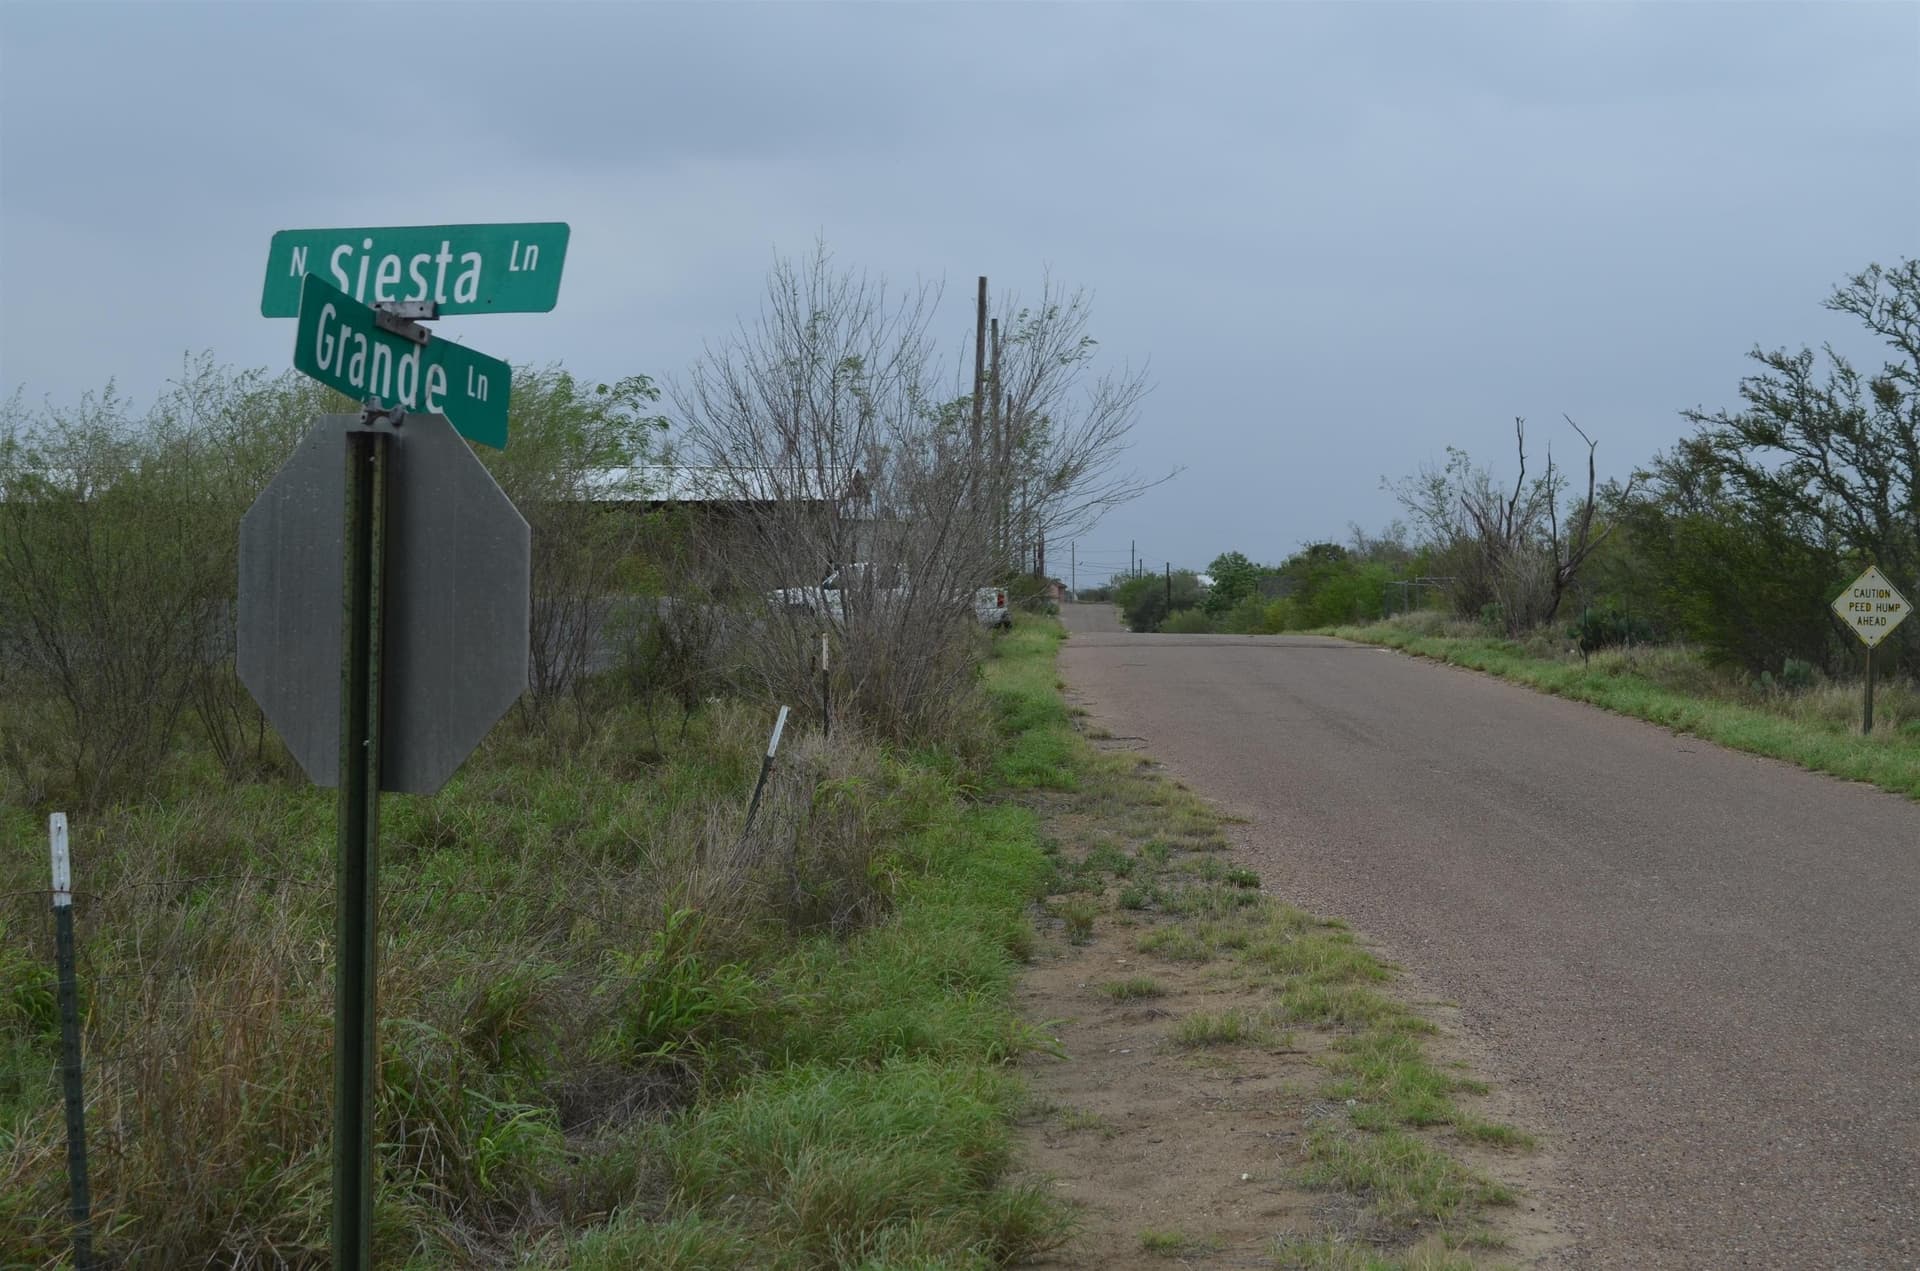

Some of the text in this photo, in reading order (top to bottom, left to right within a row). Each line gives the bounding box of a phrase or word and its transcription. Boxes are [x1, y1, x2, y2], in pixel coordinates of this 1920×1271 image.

[290, 238, 539, 304] N Siesta Ln
[315, 303, 488, 414] Grande Ln
[1854, 588, 1891, 599] CAUTION
[1876, 603, 1901, 613] HUMP
[1857, 616, 1887, 627] AHEAD
